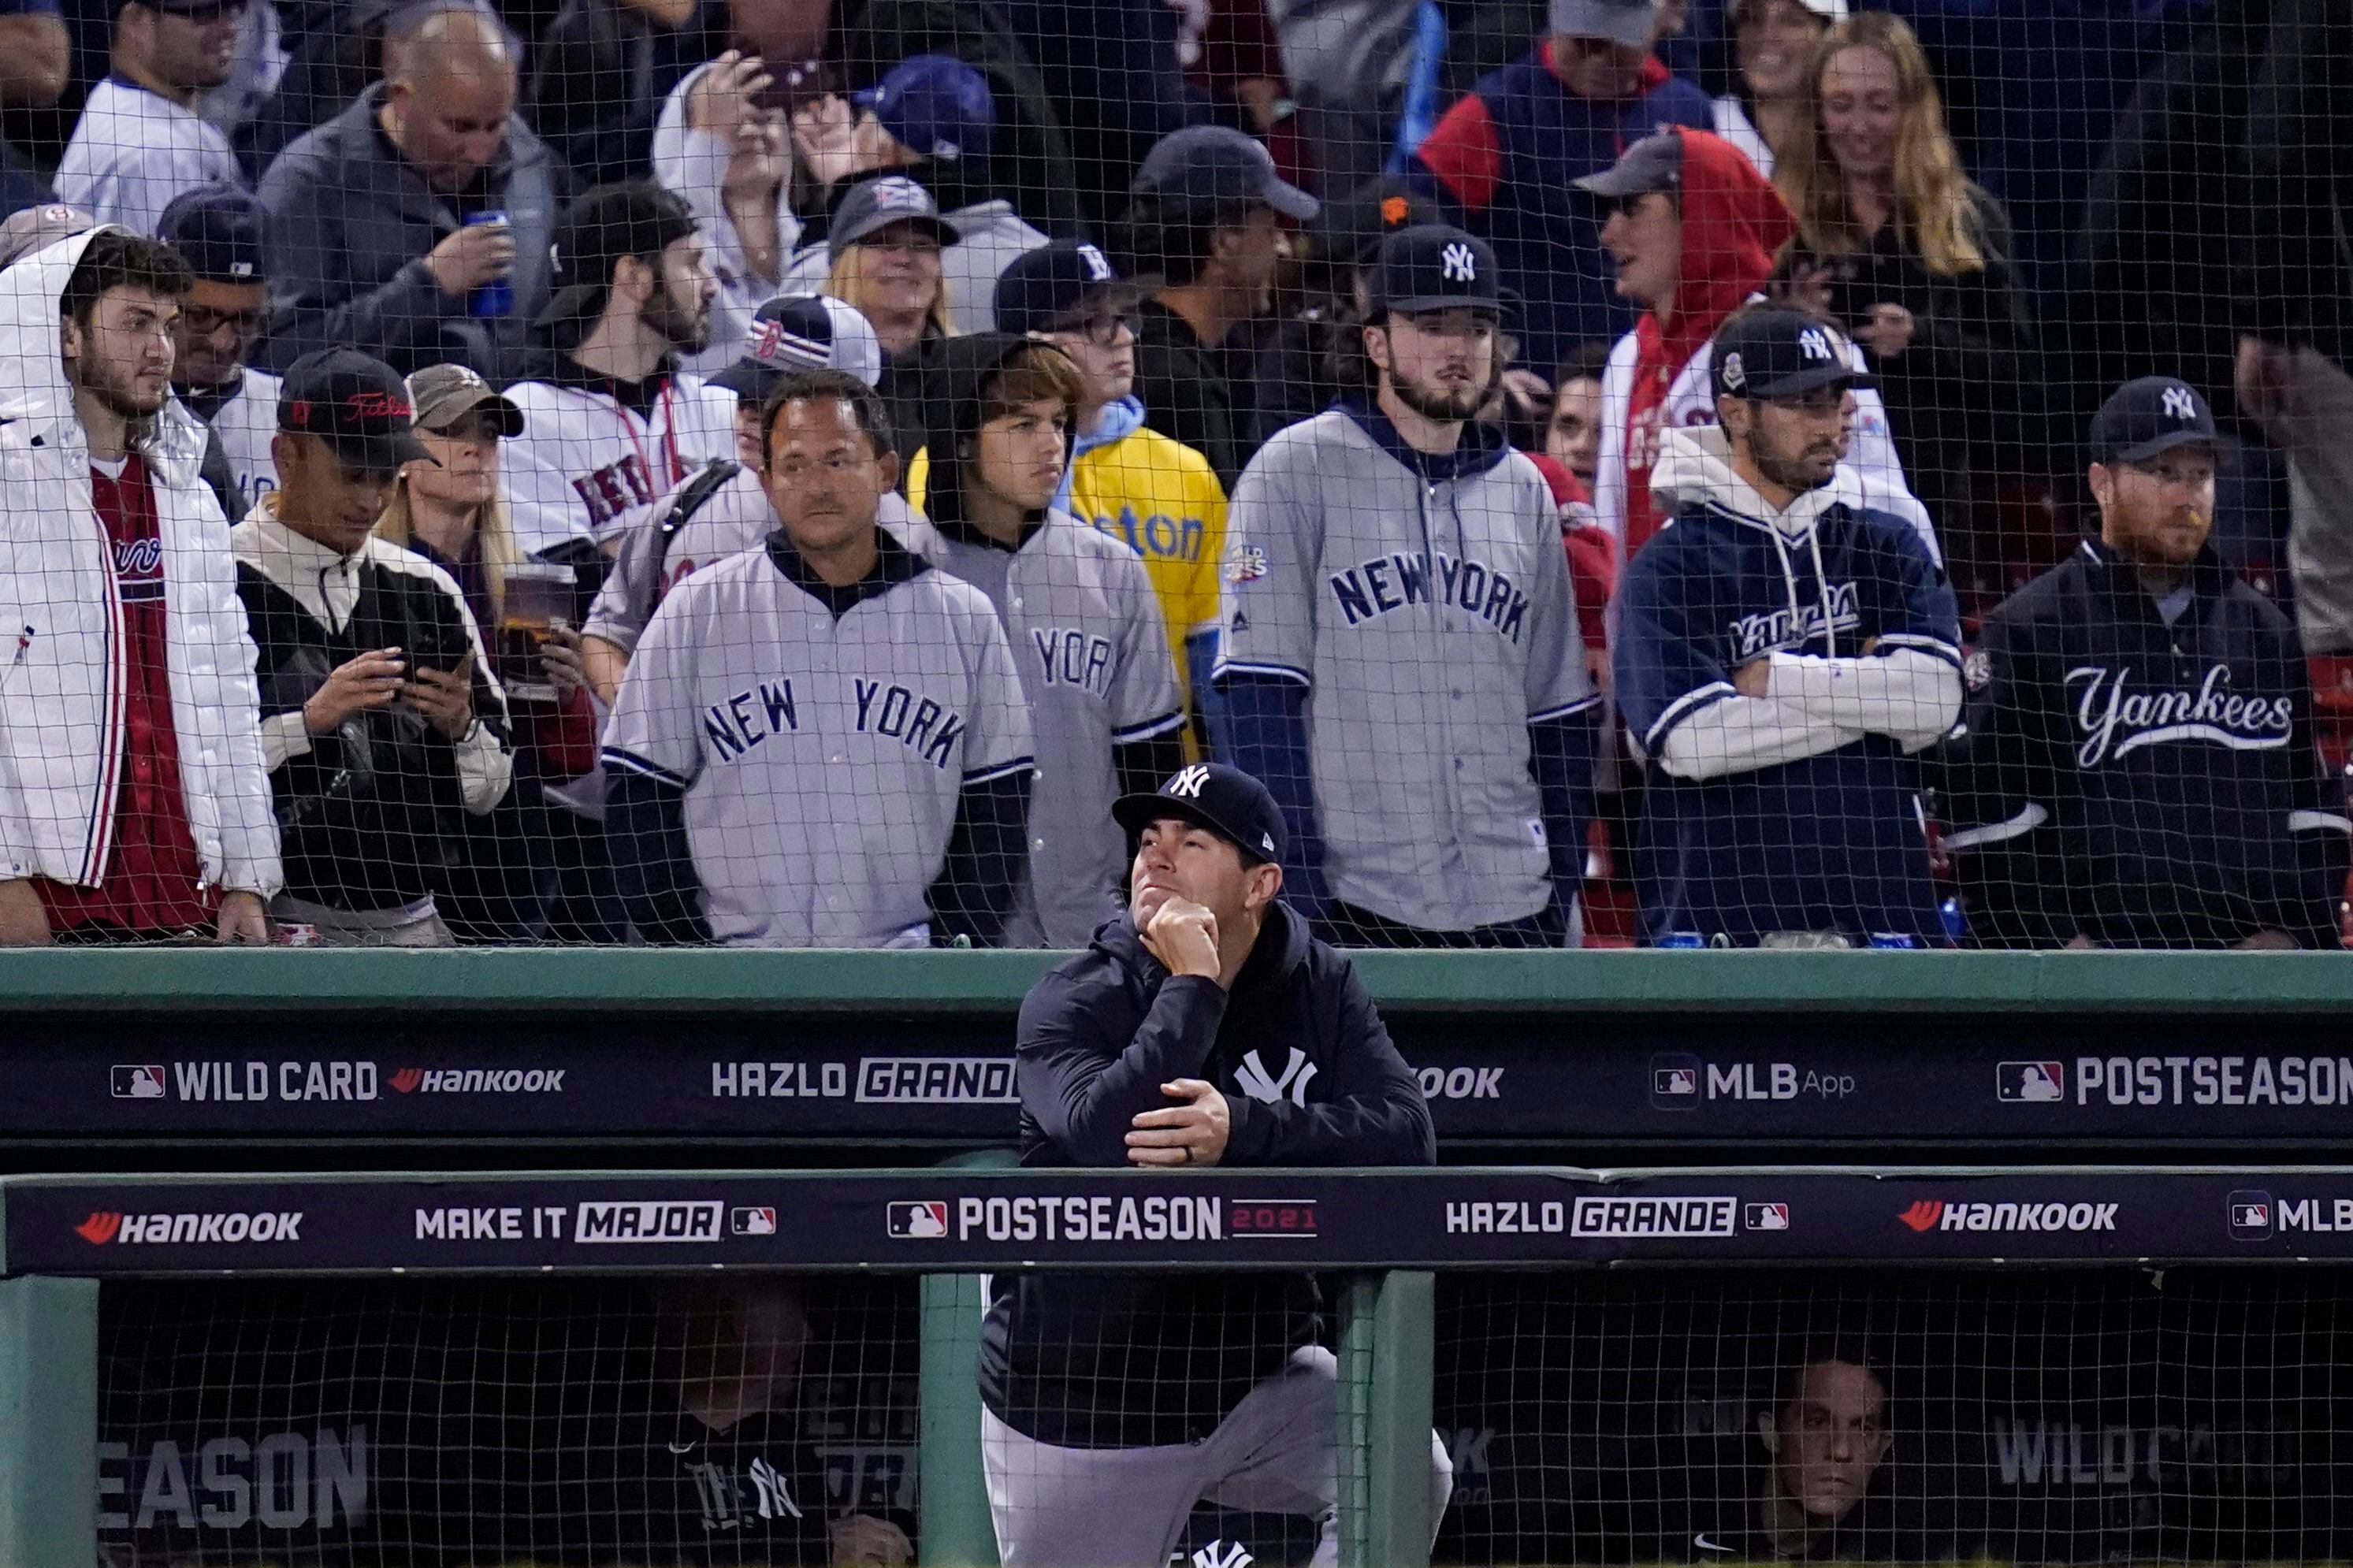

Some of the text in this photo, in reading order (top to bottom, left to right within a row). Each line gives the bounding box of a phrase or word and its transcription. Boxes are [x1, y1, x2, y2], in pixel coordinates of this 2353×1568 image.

[1442, 243, 1475, 281] NY
[1800, 329, 1831, 359] NY
[2162, 386, 2196, 419] NY
[1329, 552, 1529, 645] NEW YORK
[1031, 628, 1113, 700] YOR
[704, 678, 966, 769] NEW YORK
[2064, 664, 2292, 767] Yankees
[1169, 765, 1210, 797] NY
[173, 1061, 269, 1101] WILD
[280, 1061, 377, 1101] CARD
[712, 1062, 846, 1097] HAZLO
[1708, 1064, 1855, 1099] MLB App
[415, 1206, 715, 1239] MAKE IT MAJOR
[959, 1197, 1317, 1240] POSTSEASON 2021
[1446, 1201, 1730, 1233] HAZLO GRANDE
[1994, 1415, 2135, 1484] WILD
[748, 1455, 803, 1519] NY
